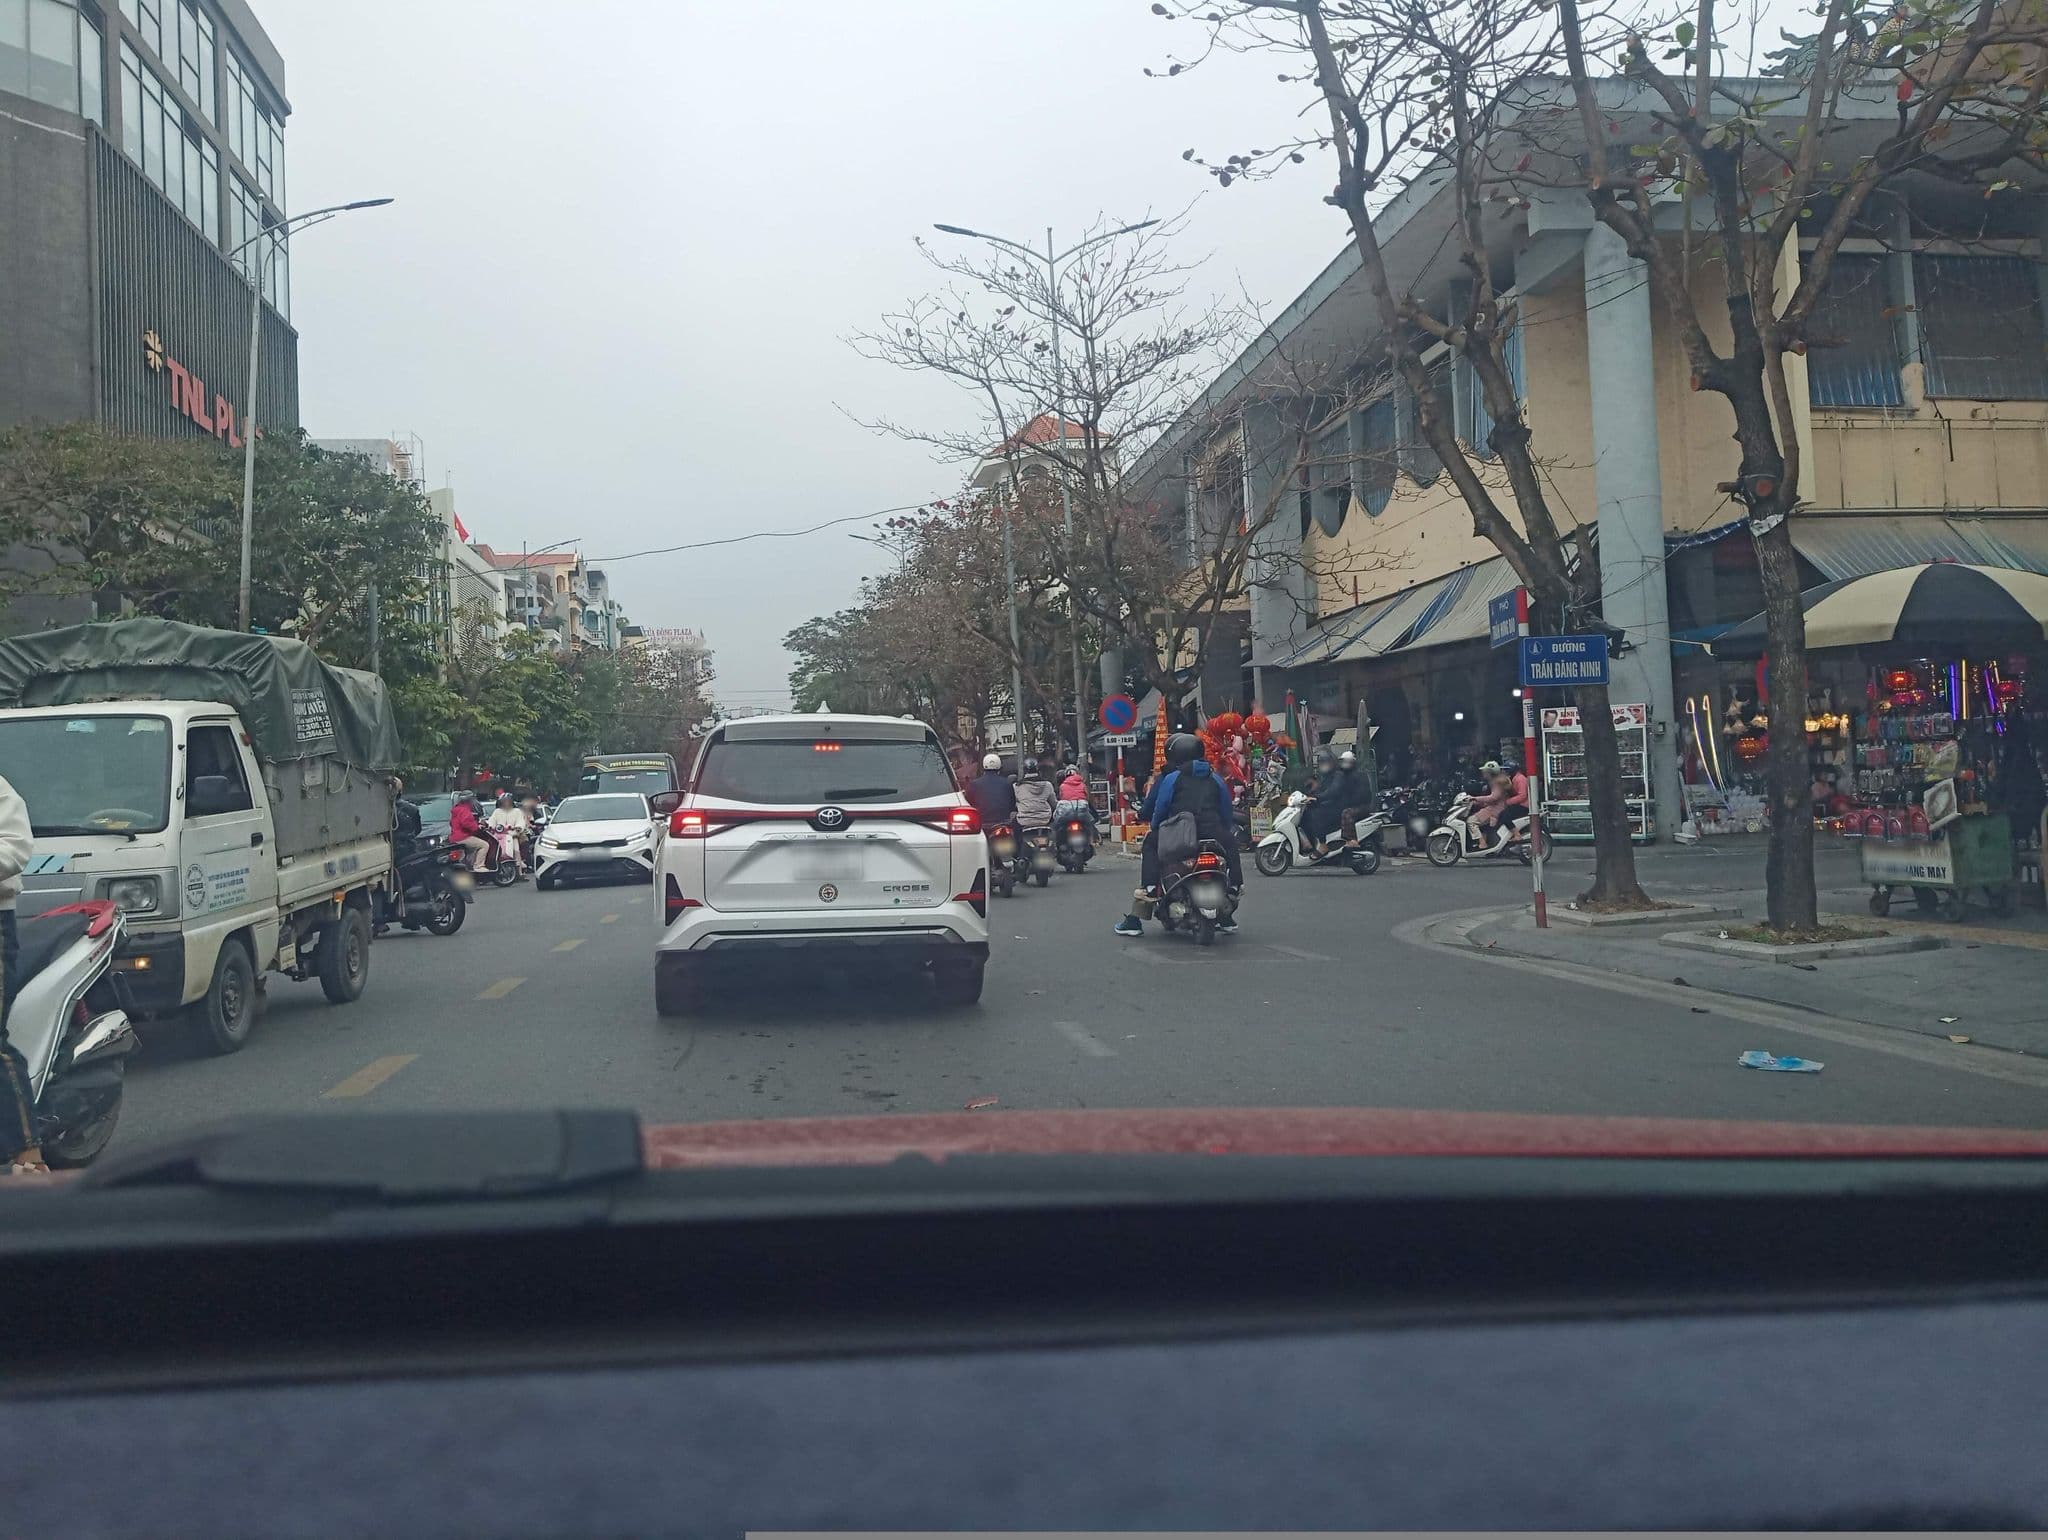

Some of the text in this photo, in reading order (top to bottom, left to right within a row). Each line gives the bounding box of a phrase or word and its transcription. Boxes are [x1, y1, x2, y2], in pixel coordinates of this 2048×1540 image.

[167, 356, 213, 433] TNL
[1551, 640, 1586, 653] ĐƯỜNG
[1531, 658, 1601, 679] TRẦN ĐĂNG NINH
[883, 884, 930, 892] CROSS
